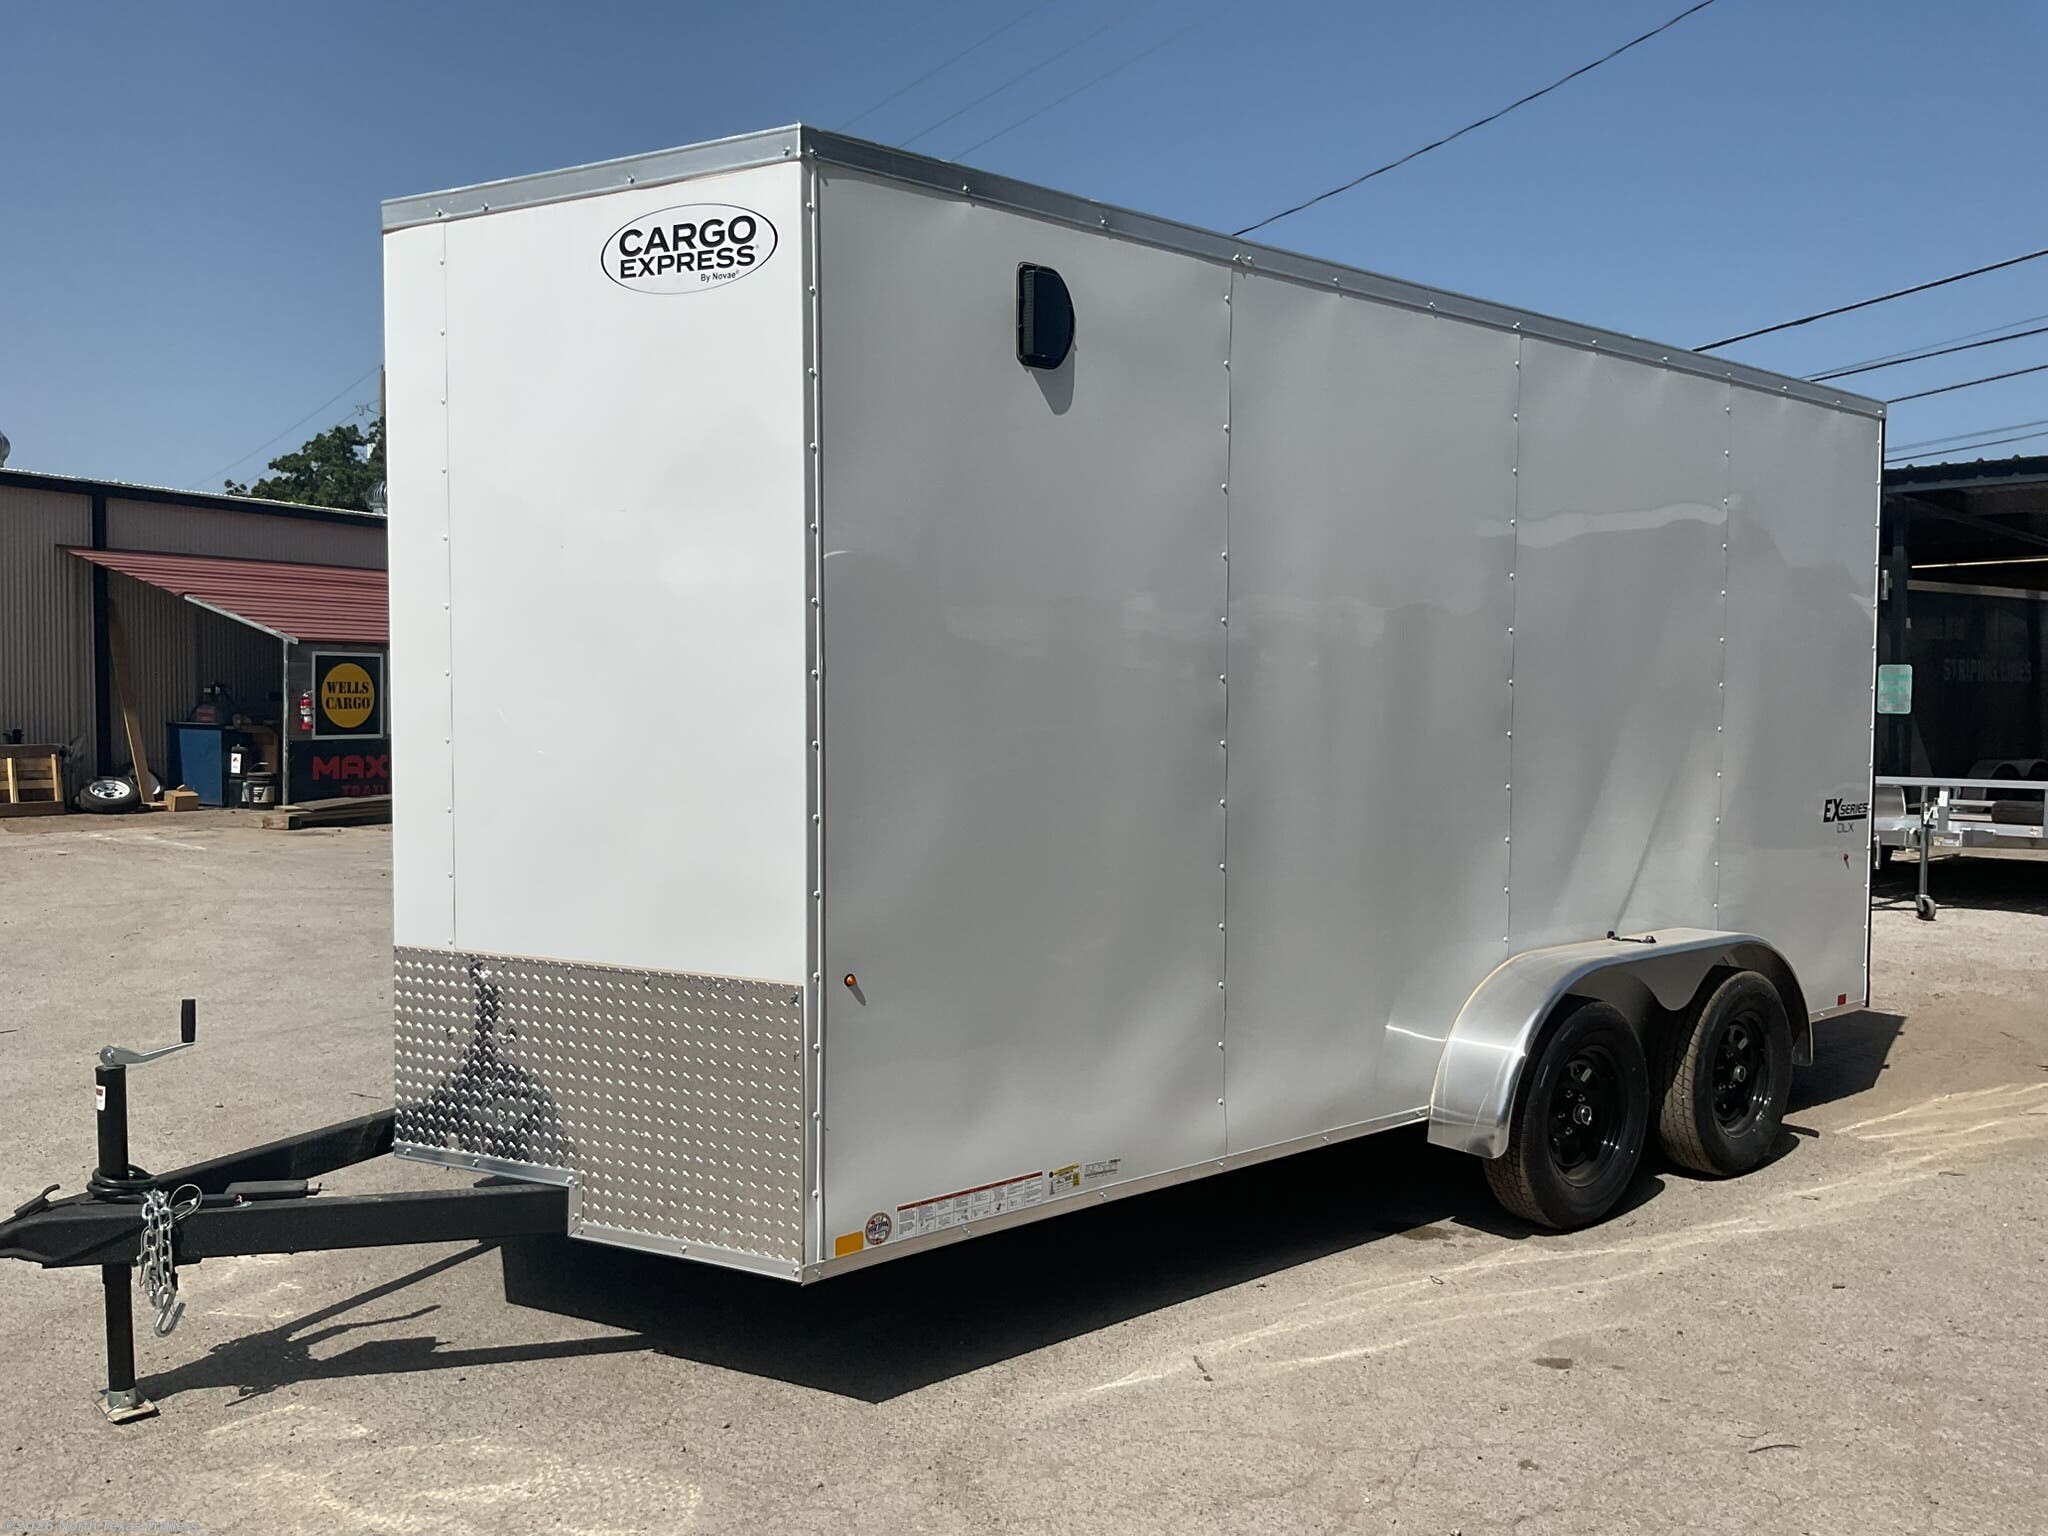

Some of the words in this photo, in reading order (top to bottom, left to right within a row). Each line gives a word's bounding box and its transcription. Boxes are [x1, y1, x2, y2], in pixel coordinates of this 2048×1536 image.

[619, 215, 757, 257] CARGO
[620, 245, 756, 279] EXPRESS
[700, 273, 711, 283] By
[326, 681, 370, 694] WELLS
[326, 697, 370, 710] CARGO
[1840, 802, 1869, 815] SERIES
[1836, 822, 1855, 834] DLX
